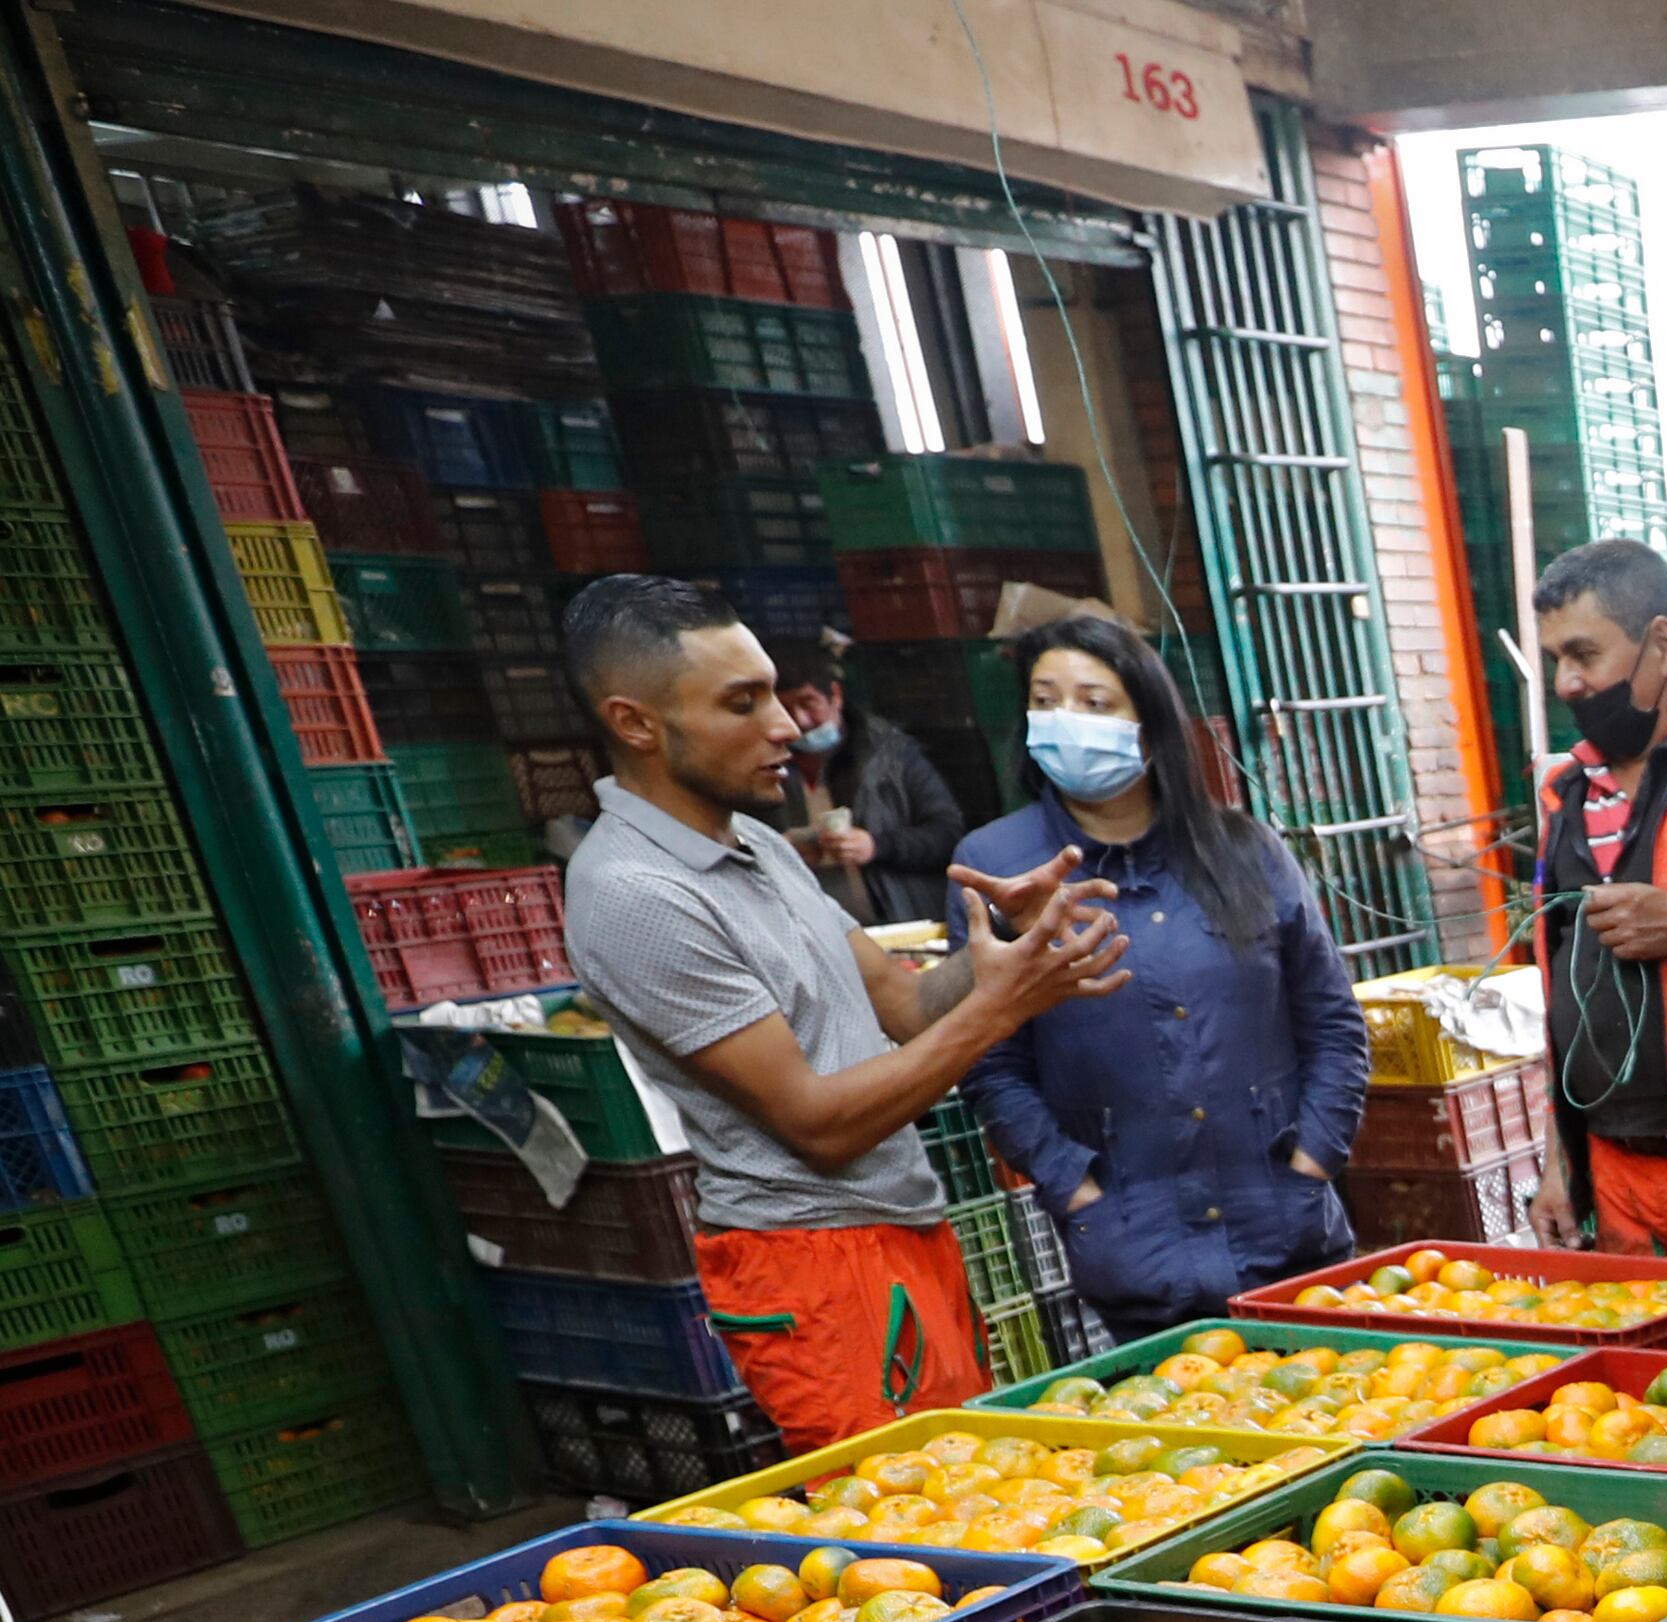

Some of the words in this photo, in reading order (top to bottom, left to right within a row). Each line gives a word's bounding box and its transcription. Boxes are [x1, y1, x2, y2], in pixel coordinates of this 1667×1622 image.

[1114, 52, 1199, 120] 163
[117, 963, 155, 986] RO
[213, 1212, 250, 1236] RO
